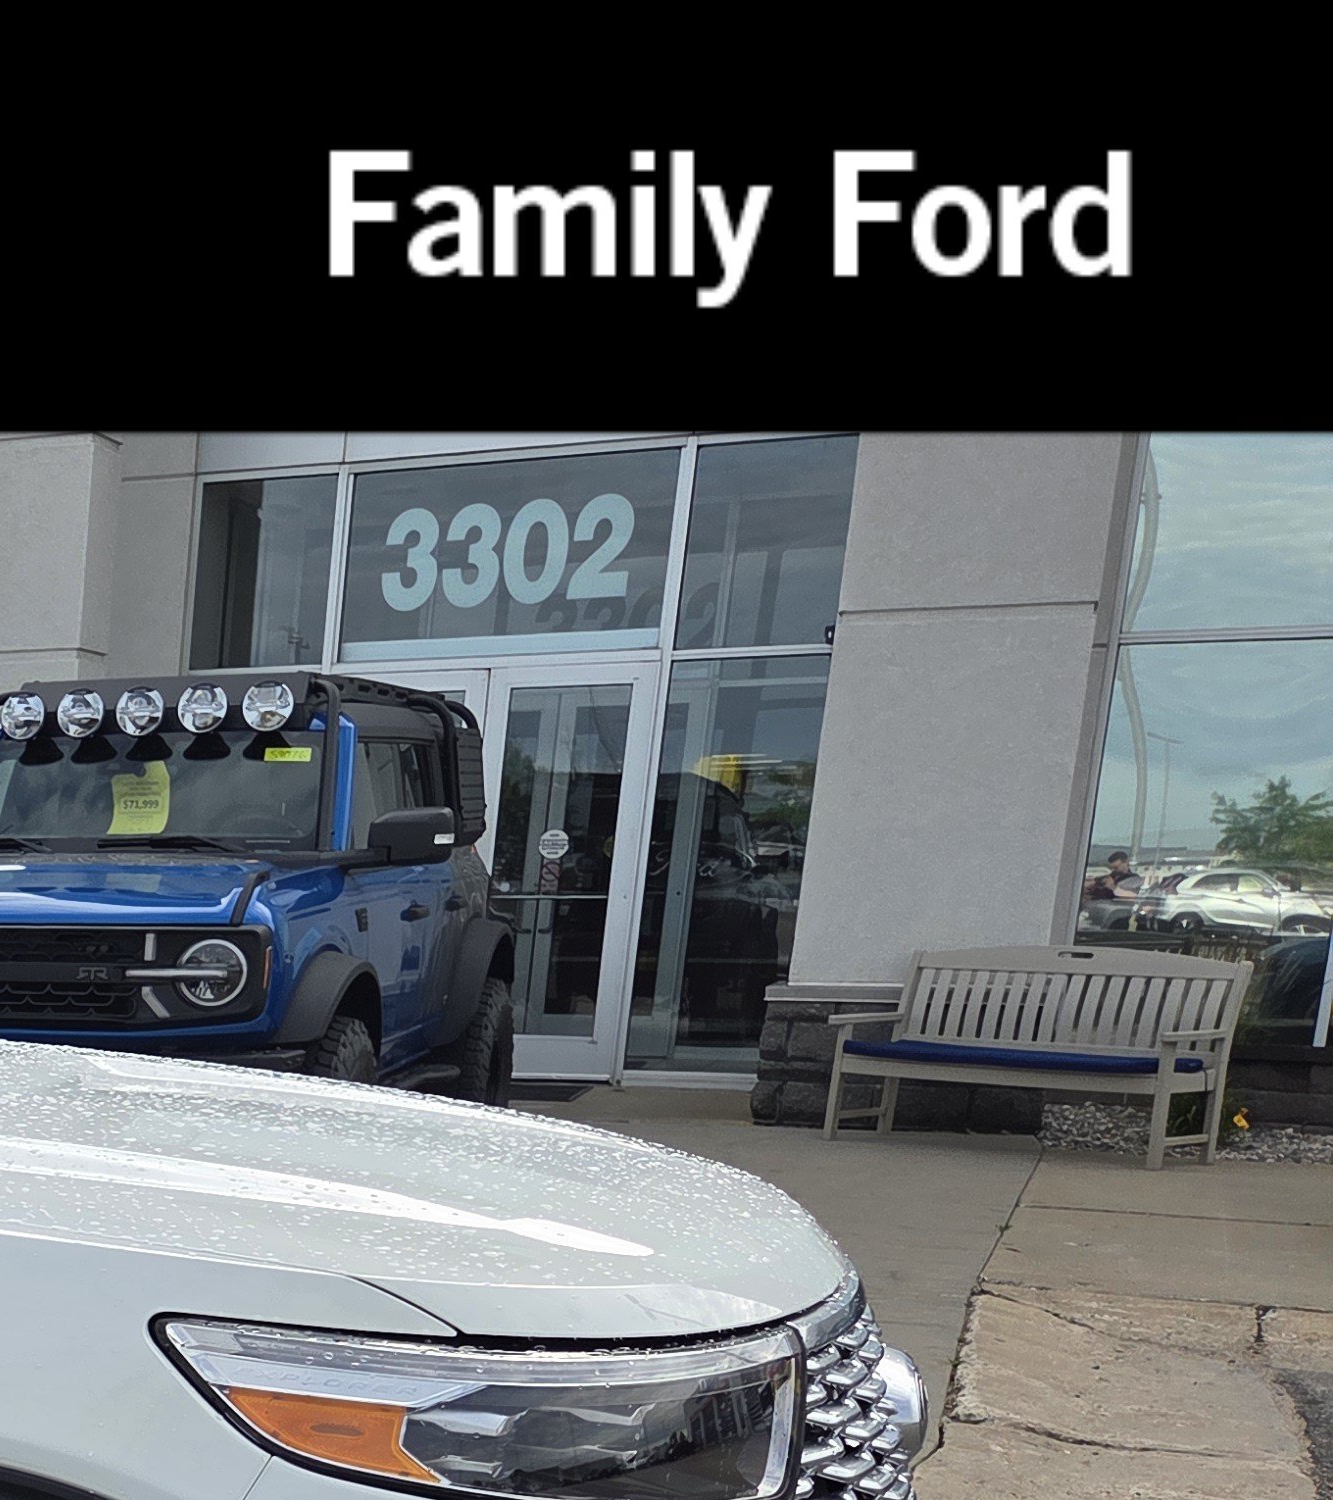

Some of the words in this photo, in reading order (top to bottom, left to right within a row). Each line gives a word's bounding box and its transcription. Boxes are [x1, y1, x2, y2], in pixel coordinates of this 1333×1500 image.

[381, 492, 635, 612] 3302
[122, 799, 159, 811] $71,999
[233, 1366, 418, 1396] EXPLORER
